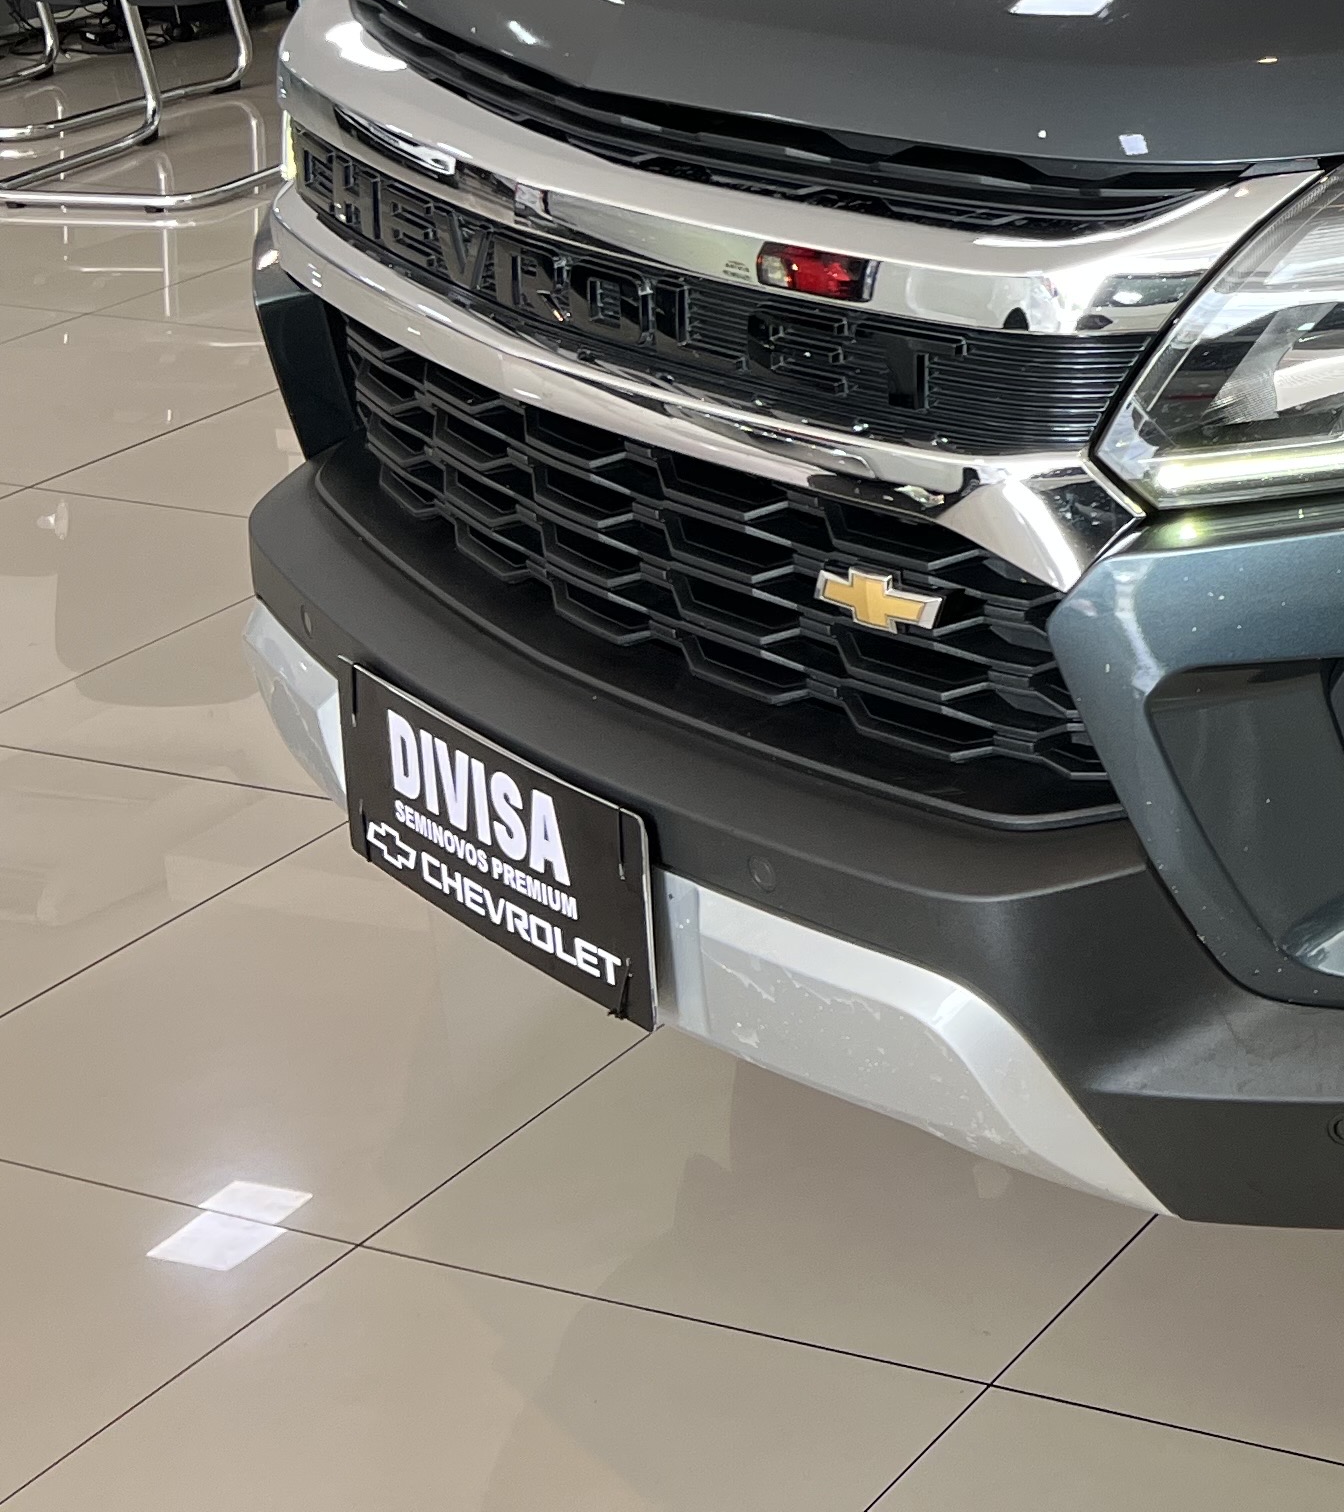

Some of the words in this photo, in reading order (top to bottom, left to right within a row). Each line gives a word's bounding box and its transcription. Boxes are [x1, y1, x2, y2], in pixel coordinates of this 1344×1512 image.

[297, 126, 968, 413] CHEVROLET
[387, 708, 571, 886] DIVISA
[395, 799, 488, 874] SEMINOVOS
[492, 856, 579, 921] PREMIUM
[422, 851, 622, 986] CHEVROLET
